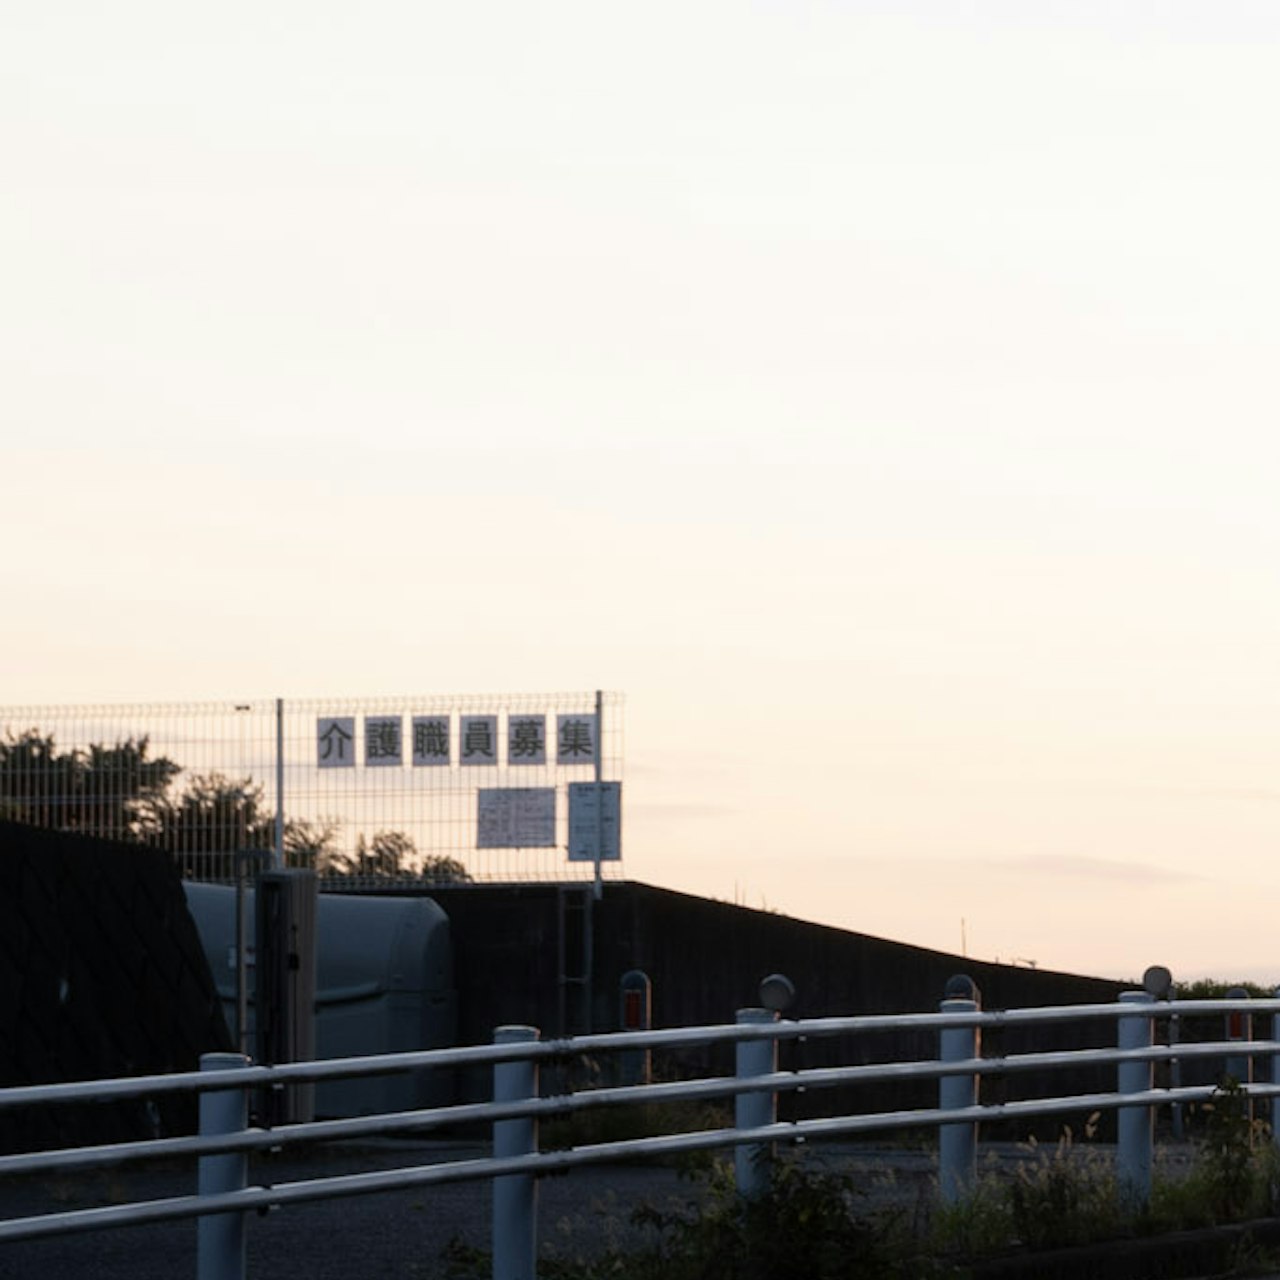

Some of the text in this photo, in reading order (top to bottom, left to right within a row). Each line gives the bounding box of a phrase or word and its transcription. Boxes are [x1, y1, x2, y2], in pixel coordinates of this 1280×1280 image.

[320, 720, 592, 759] 介護職員募集
